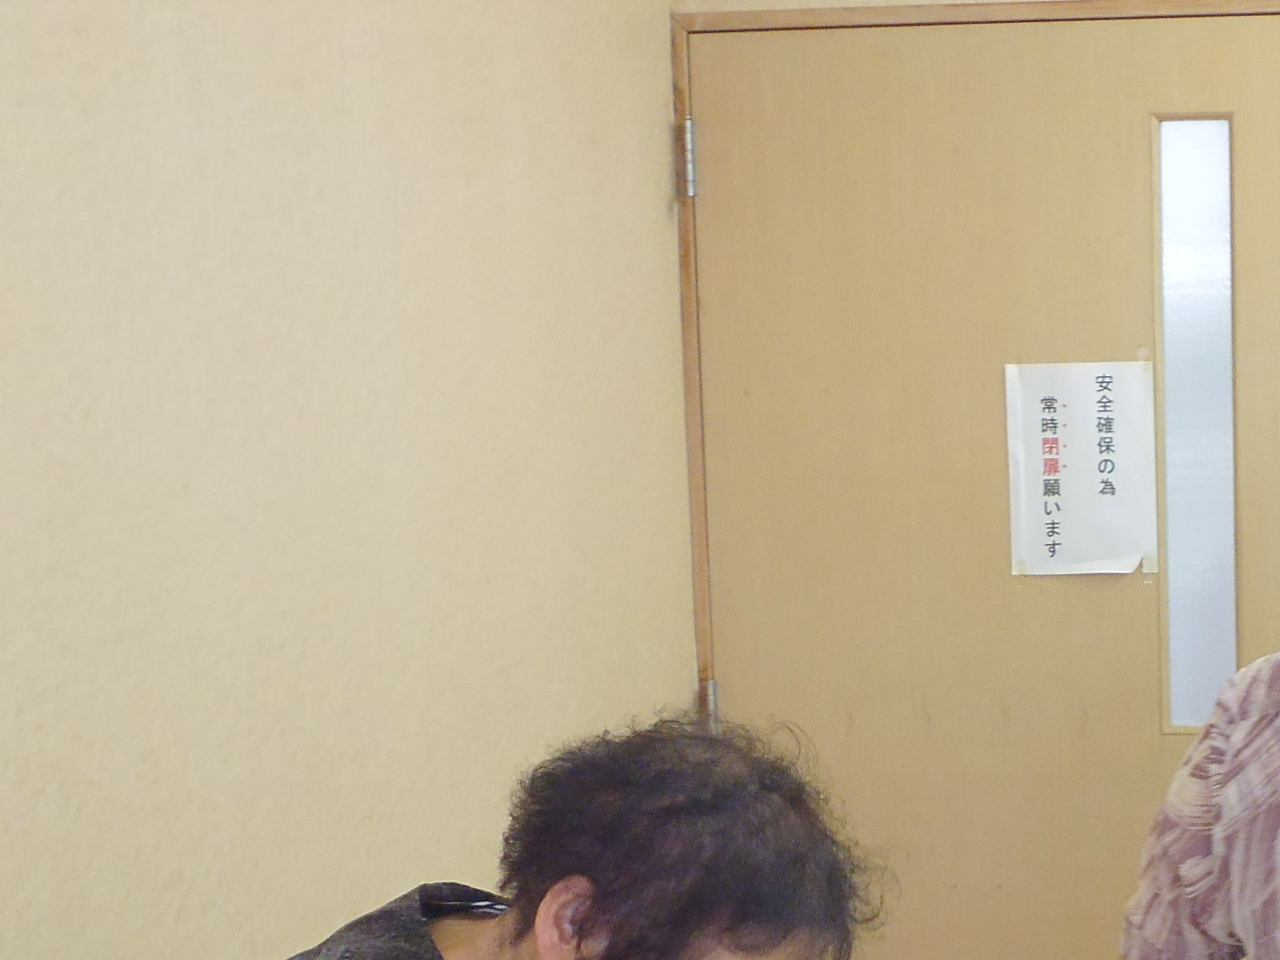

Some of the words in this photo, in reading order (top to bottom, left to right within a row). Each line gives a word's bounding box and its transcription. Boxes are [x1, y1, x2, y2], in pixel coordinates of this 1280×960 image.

[1040, 396, 1062, 558] 常時閉扉願います
[1095, 374, 1117, 496] 安全確保の為
